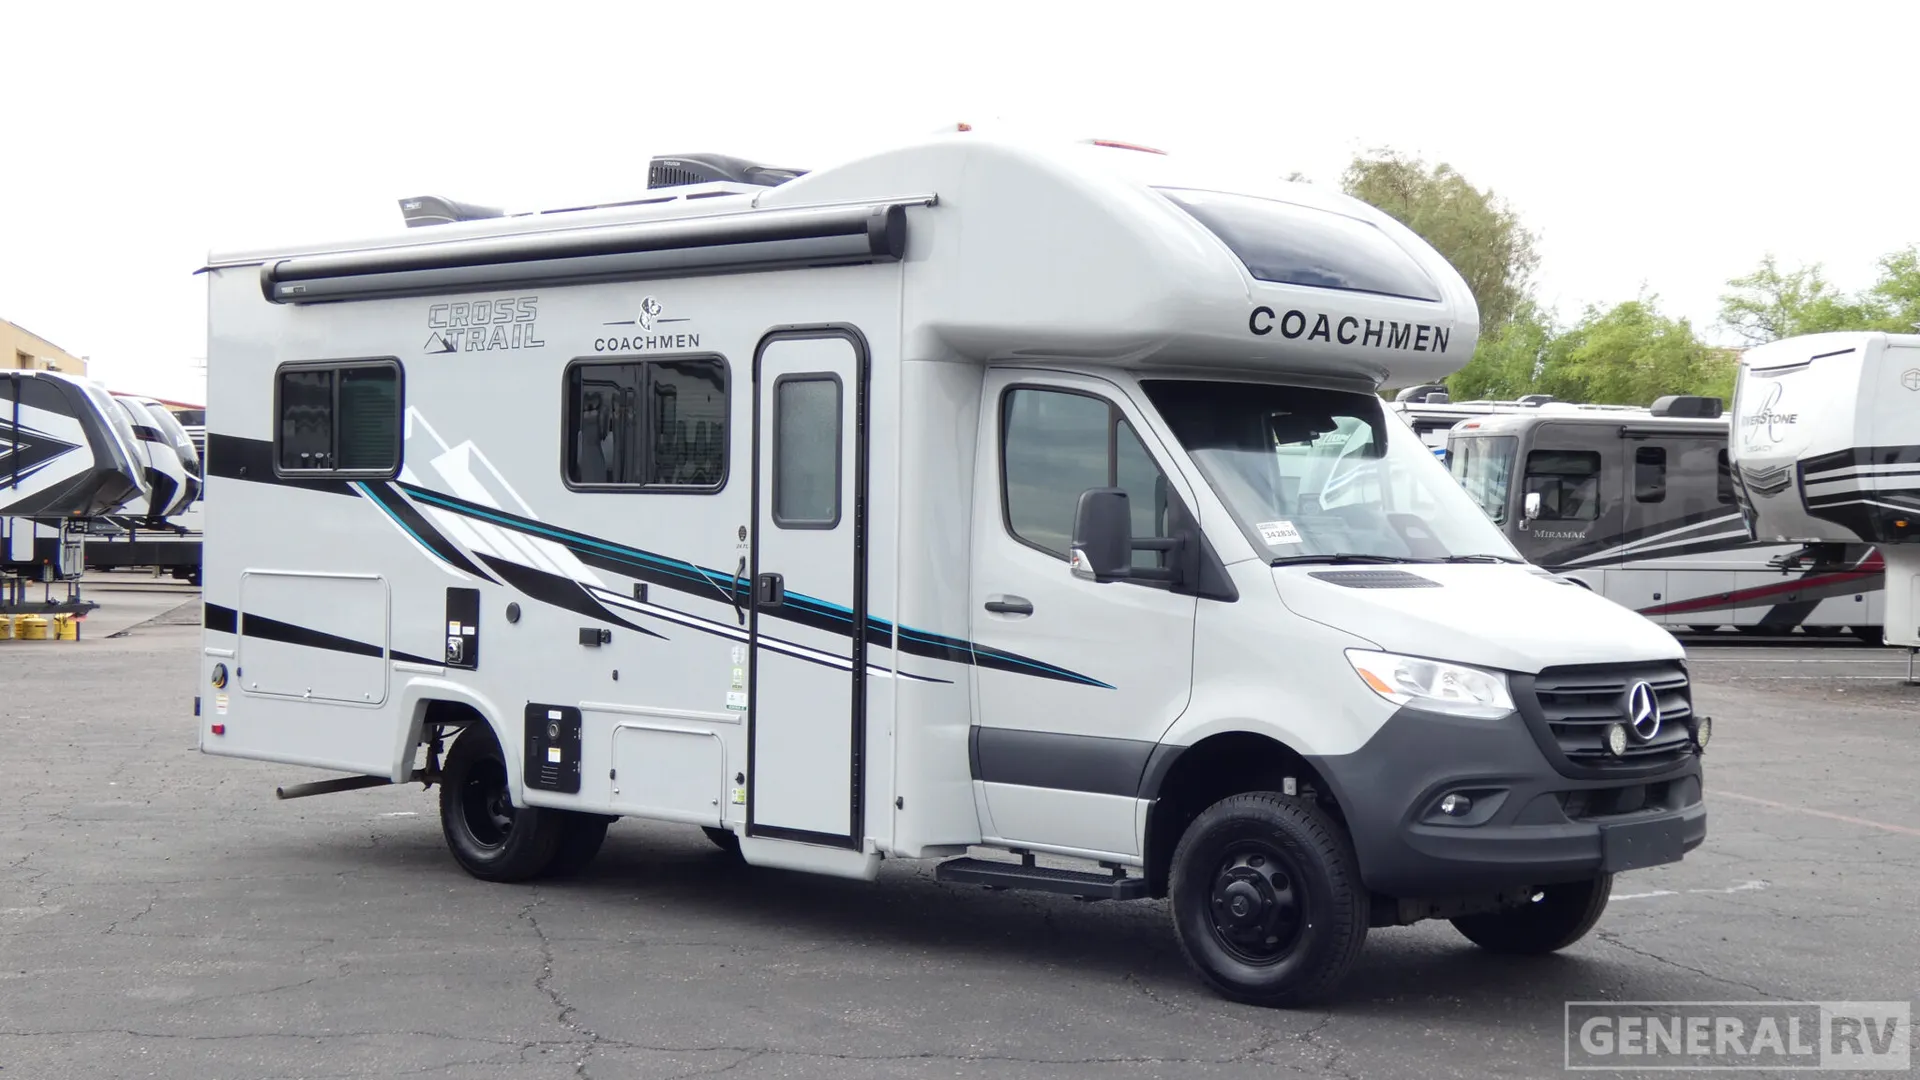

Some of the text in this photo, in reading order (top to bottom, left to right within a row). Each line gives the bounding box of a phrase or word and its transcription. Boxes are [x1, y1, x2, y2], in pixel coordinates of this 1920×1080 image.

[428, 296, 538, 328] CROSS
[445, 323, 545, 352] TRAIL
[594, 334, 700, 351] COACHMEN
[1249, 306, 1450, 353] COACHMEN
[1534, 530, 1586, 538] MIRAMAR
